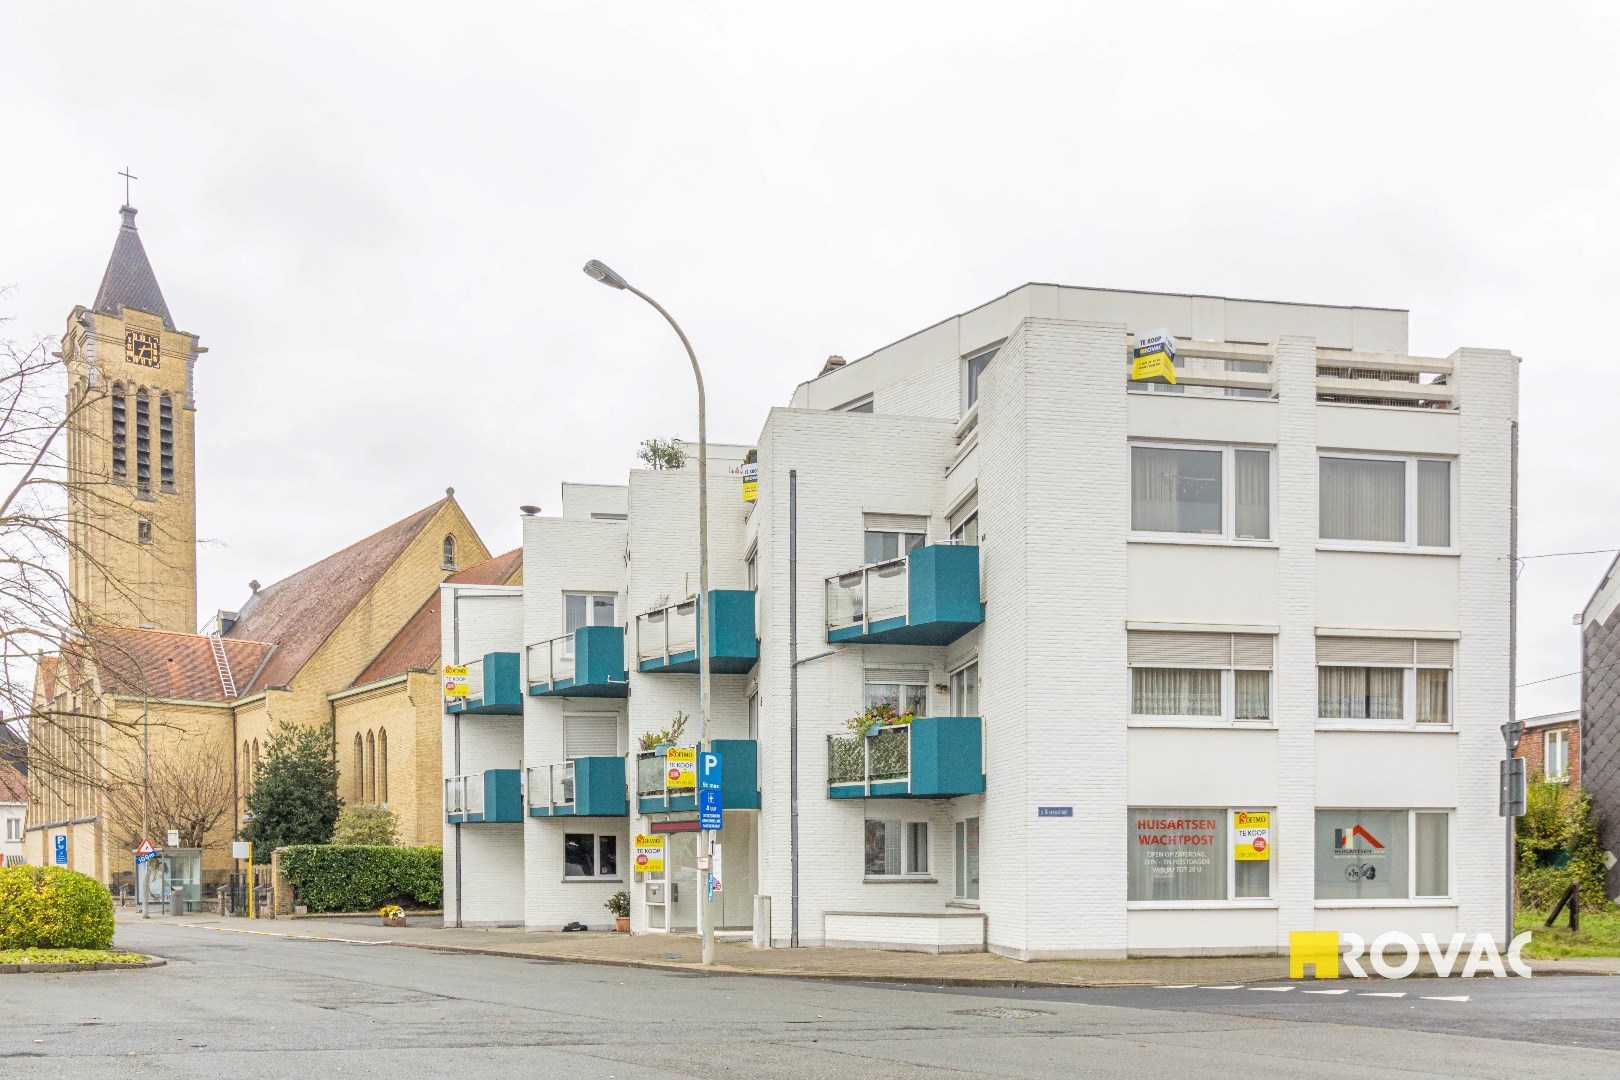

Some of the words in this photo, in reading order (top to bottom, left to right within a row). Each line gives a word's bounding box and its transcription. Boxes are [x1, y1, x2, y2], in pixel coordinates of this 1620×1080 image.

[1147, 335, 1162, 344] KOOP
[705, 754, 718, 776] P
[1137, 819, 1216, 830] HUISARTSEN
[1247, 829, 1266, 837] KOOP
[57, 836, 65, 845] P
[1138, 834, 1215, 846] WACHTPOST
